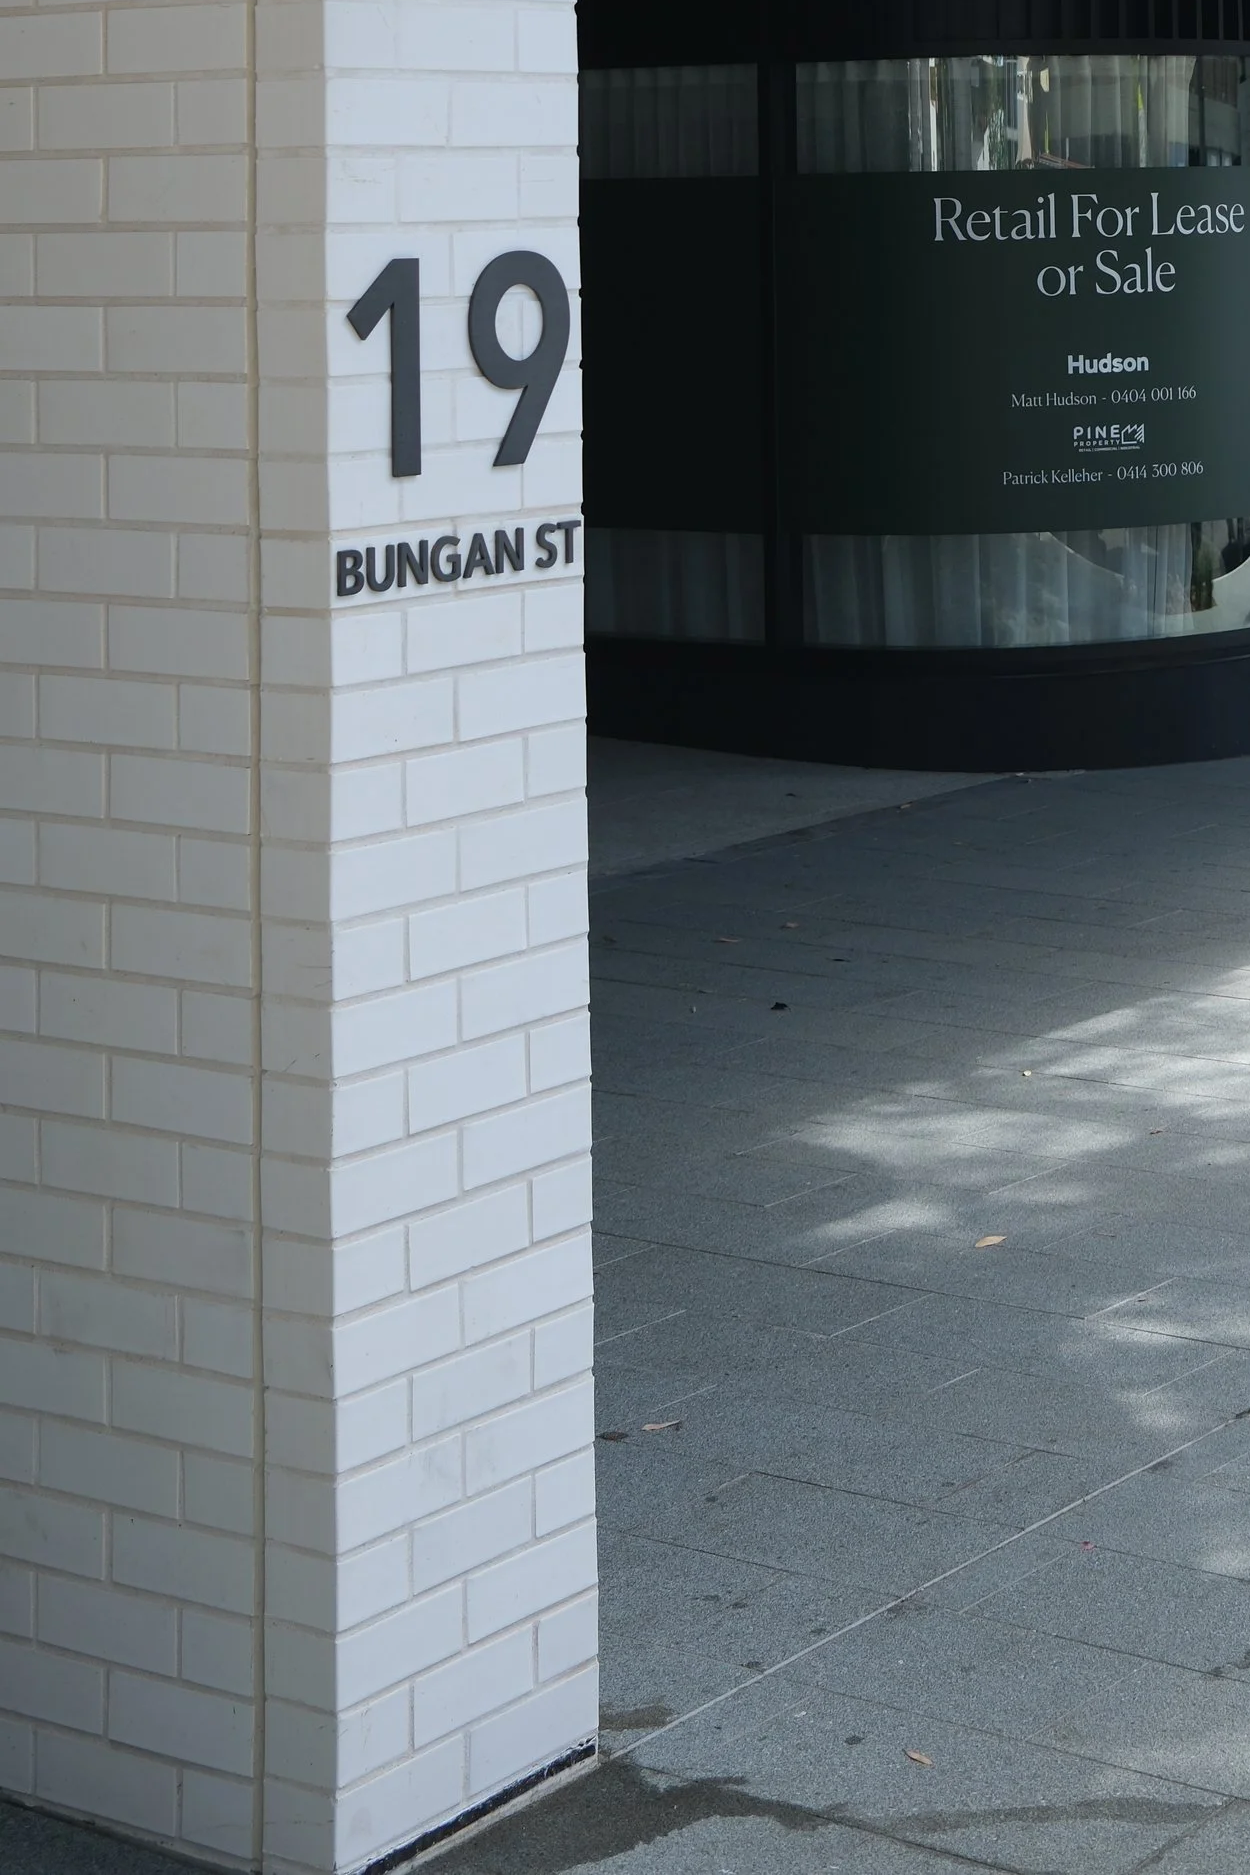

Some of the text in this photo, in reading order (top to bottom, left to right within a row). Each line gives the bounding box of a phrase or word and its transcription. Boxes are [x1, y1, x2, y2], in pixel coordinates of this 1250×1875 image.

[932, 191, 1246, 242] Retail For Lease
[1036, 247, 1177, 297] or Sale
[346, 249, 571, 478] 19
[1067, 352, 1150, 375] Hudson
[1011, 392, 1043, 408] Matt
[1045, 391, 1098, 406] Hudson
[1111, 388, 1147, 404] 0404
[1151, 386, 1174, 402] 001
[1177, 385, 1197, 401] 166
[1073, 424, 1121, 440] PINE
[1073, 439, 1121, 448] PROPERTY
[1002, 470, 1049, 485] Patrick
[1051, 468, 1103, 484] Kelleher
[1116, 465, 1147, 481] 0414
[1151, 462, 1178, 478] 300
[1181, 460, 1204, 476] 806
[336, 519, 582, 597] BUNGAN ST
